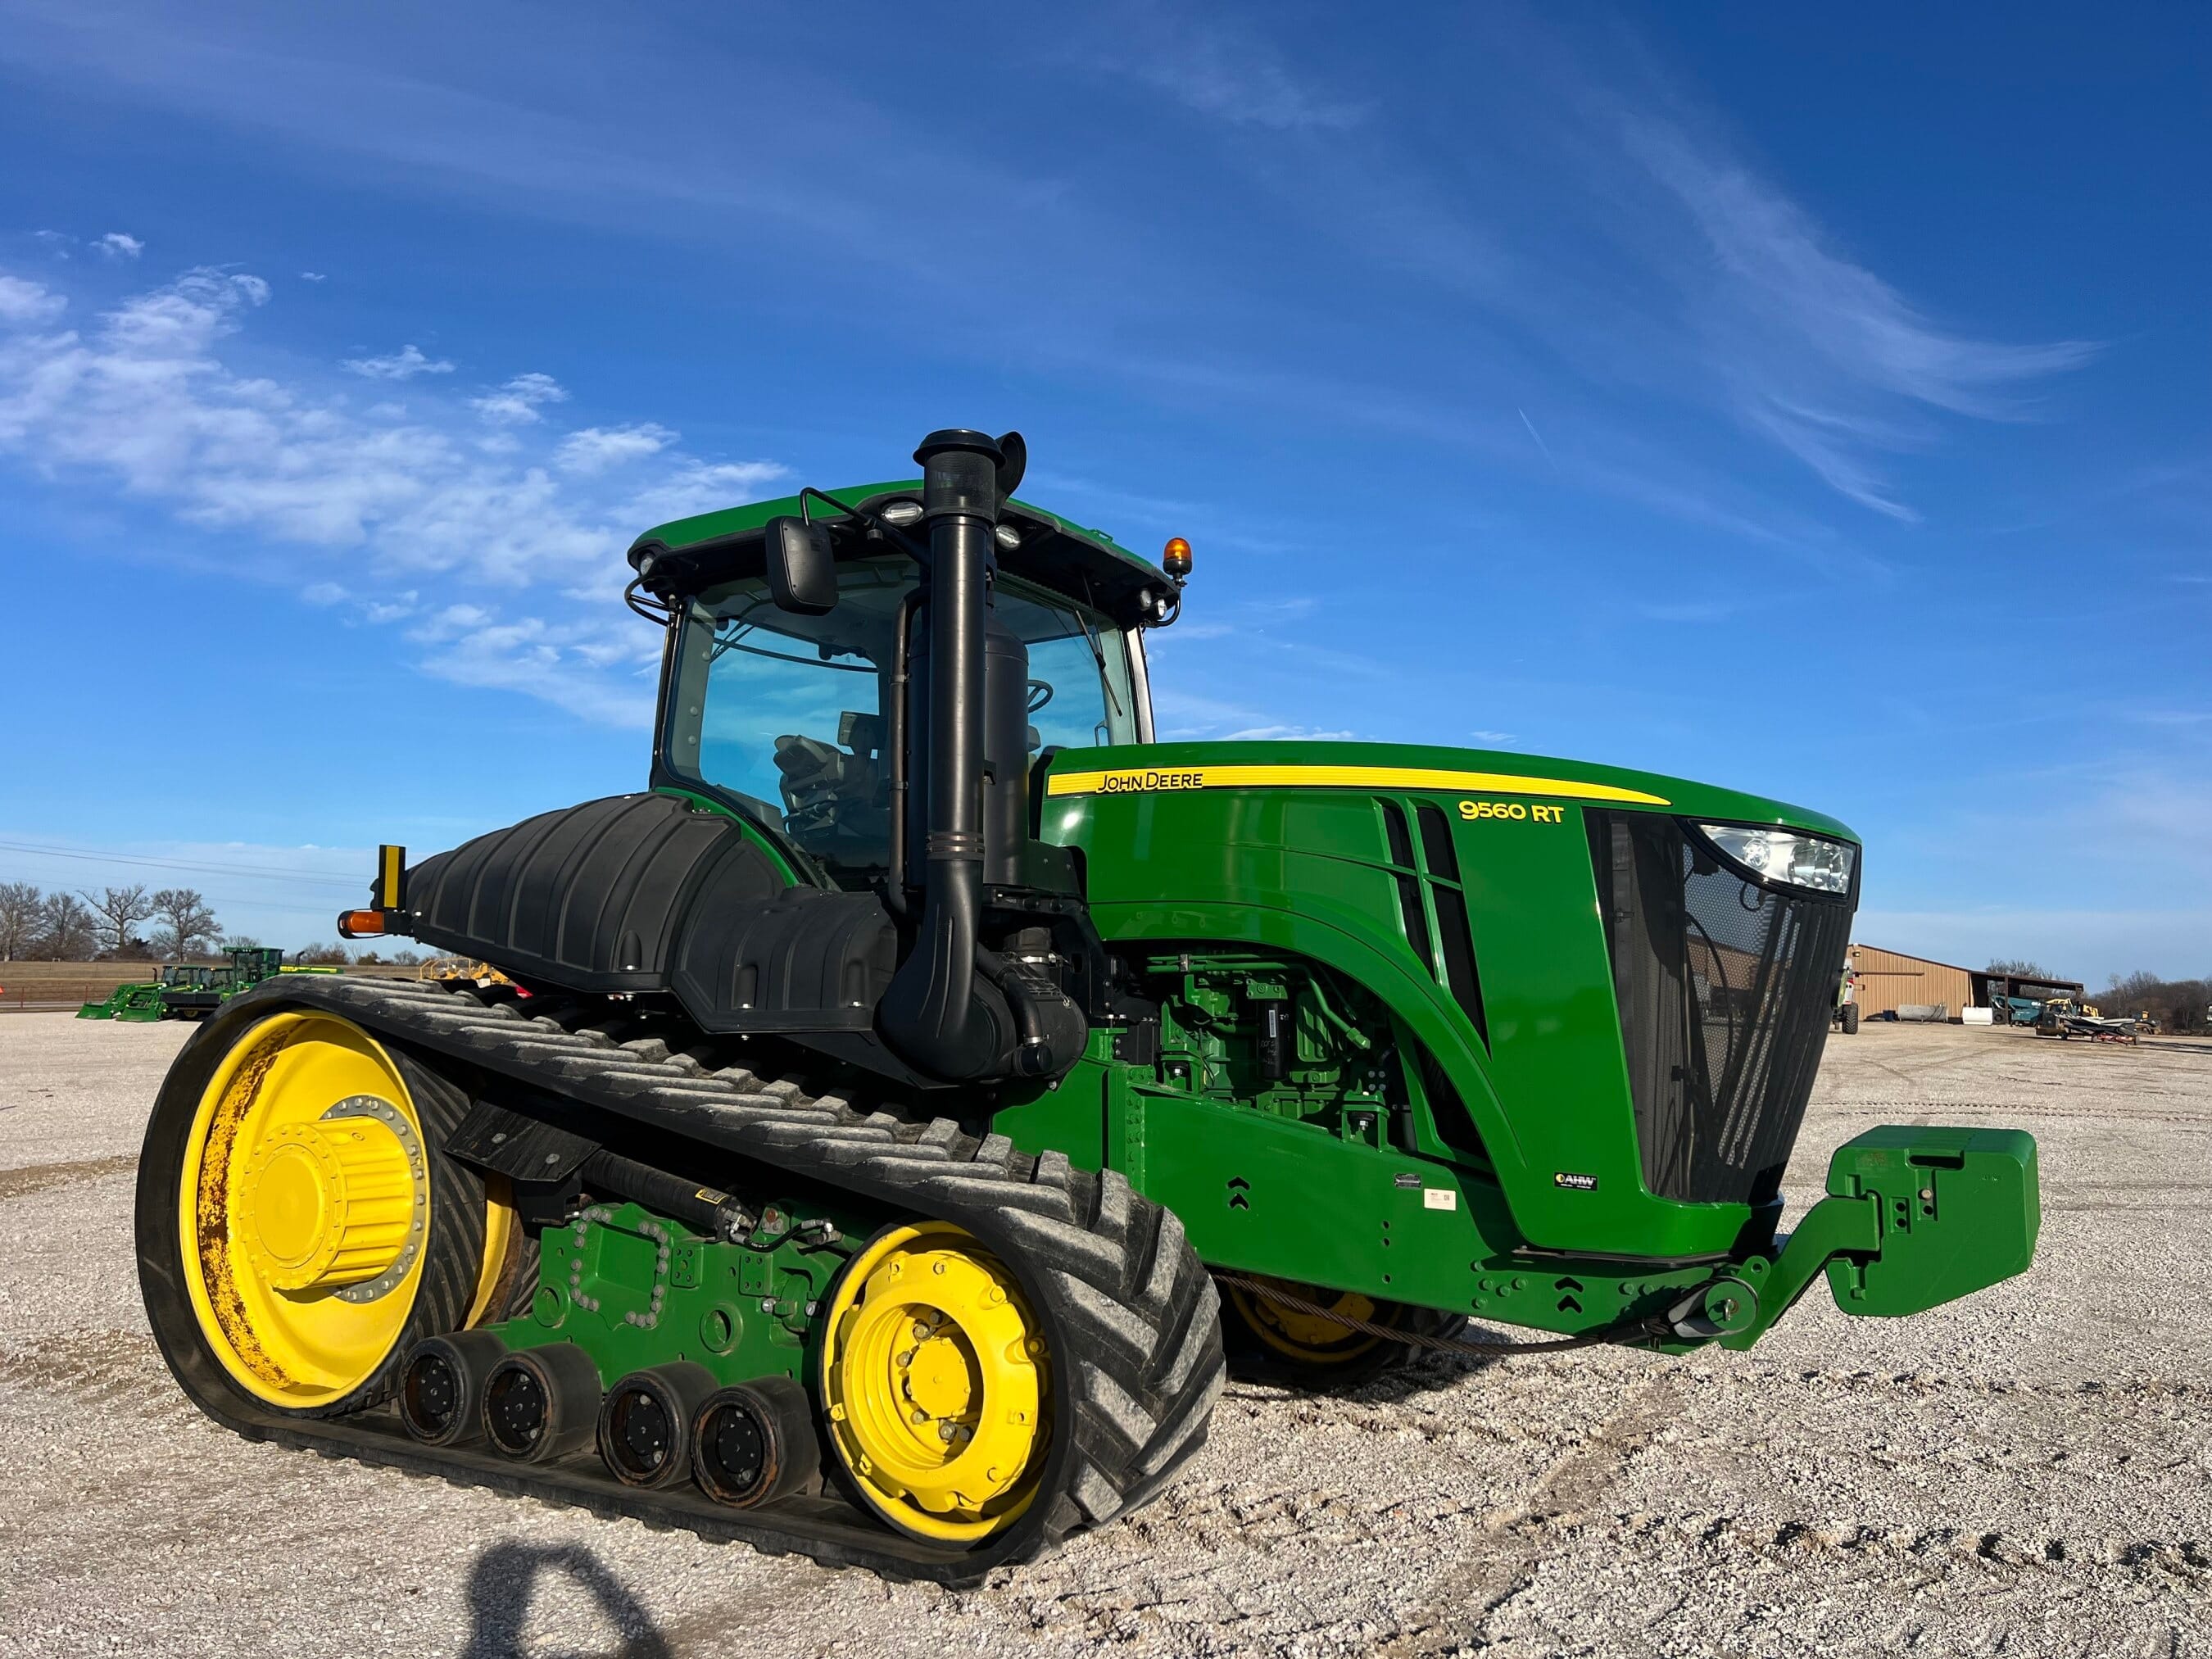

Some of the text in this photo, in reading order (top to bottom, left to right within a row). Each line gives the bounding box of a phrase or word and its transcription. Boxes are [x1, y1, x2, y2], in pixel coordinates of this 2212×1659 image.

[1097, 772, 1203, 791] JOHN DEERE
[1458, 800, 1565, 823] 9560 RT
[1565, 1174, 1593, 1186] AHW
